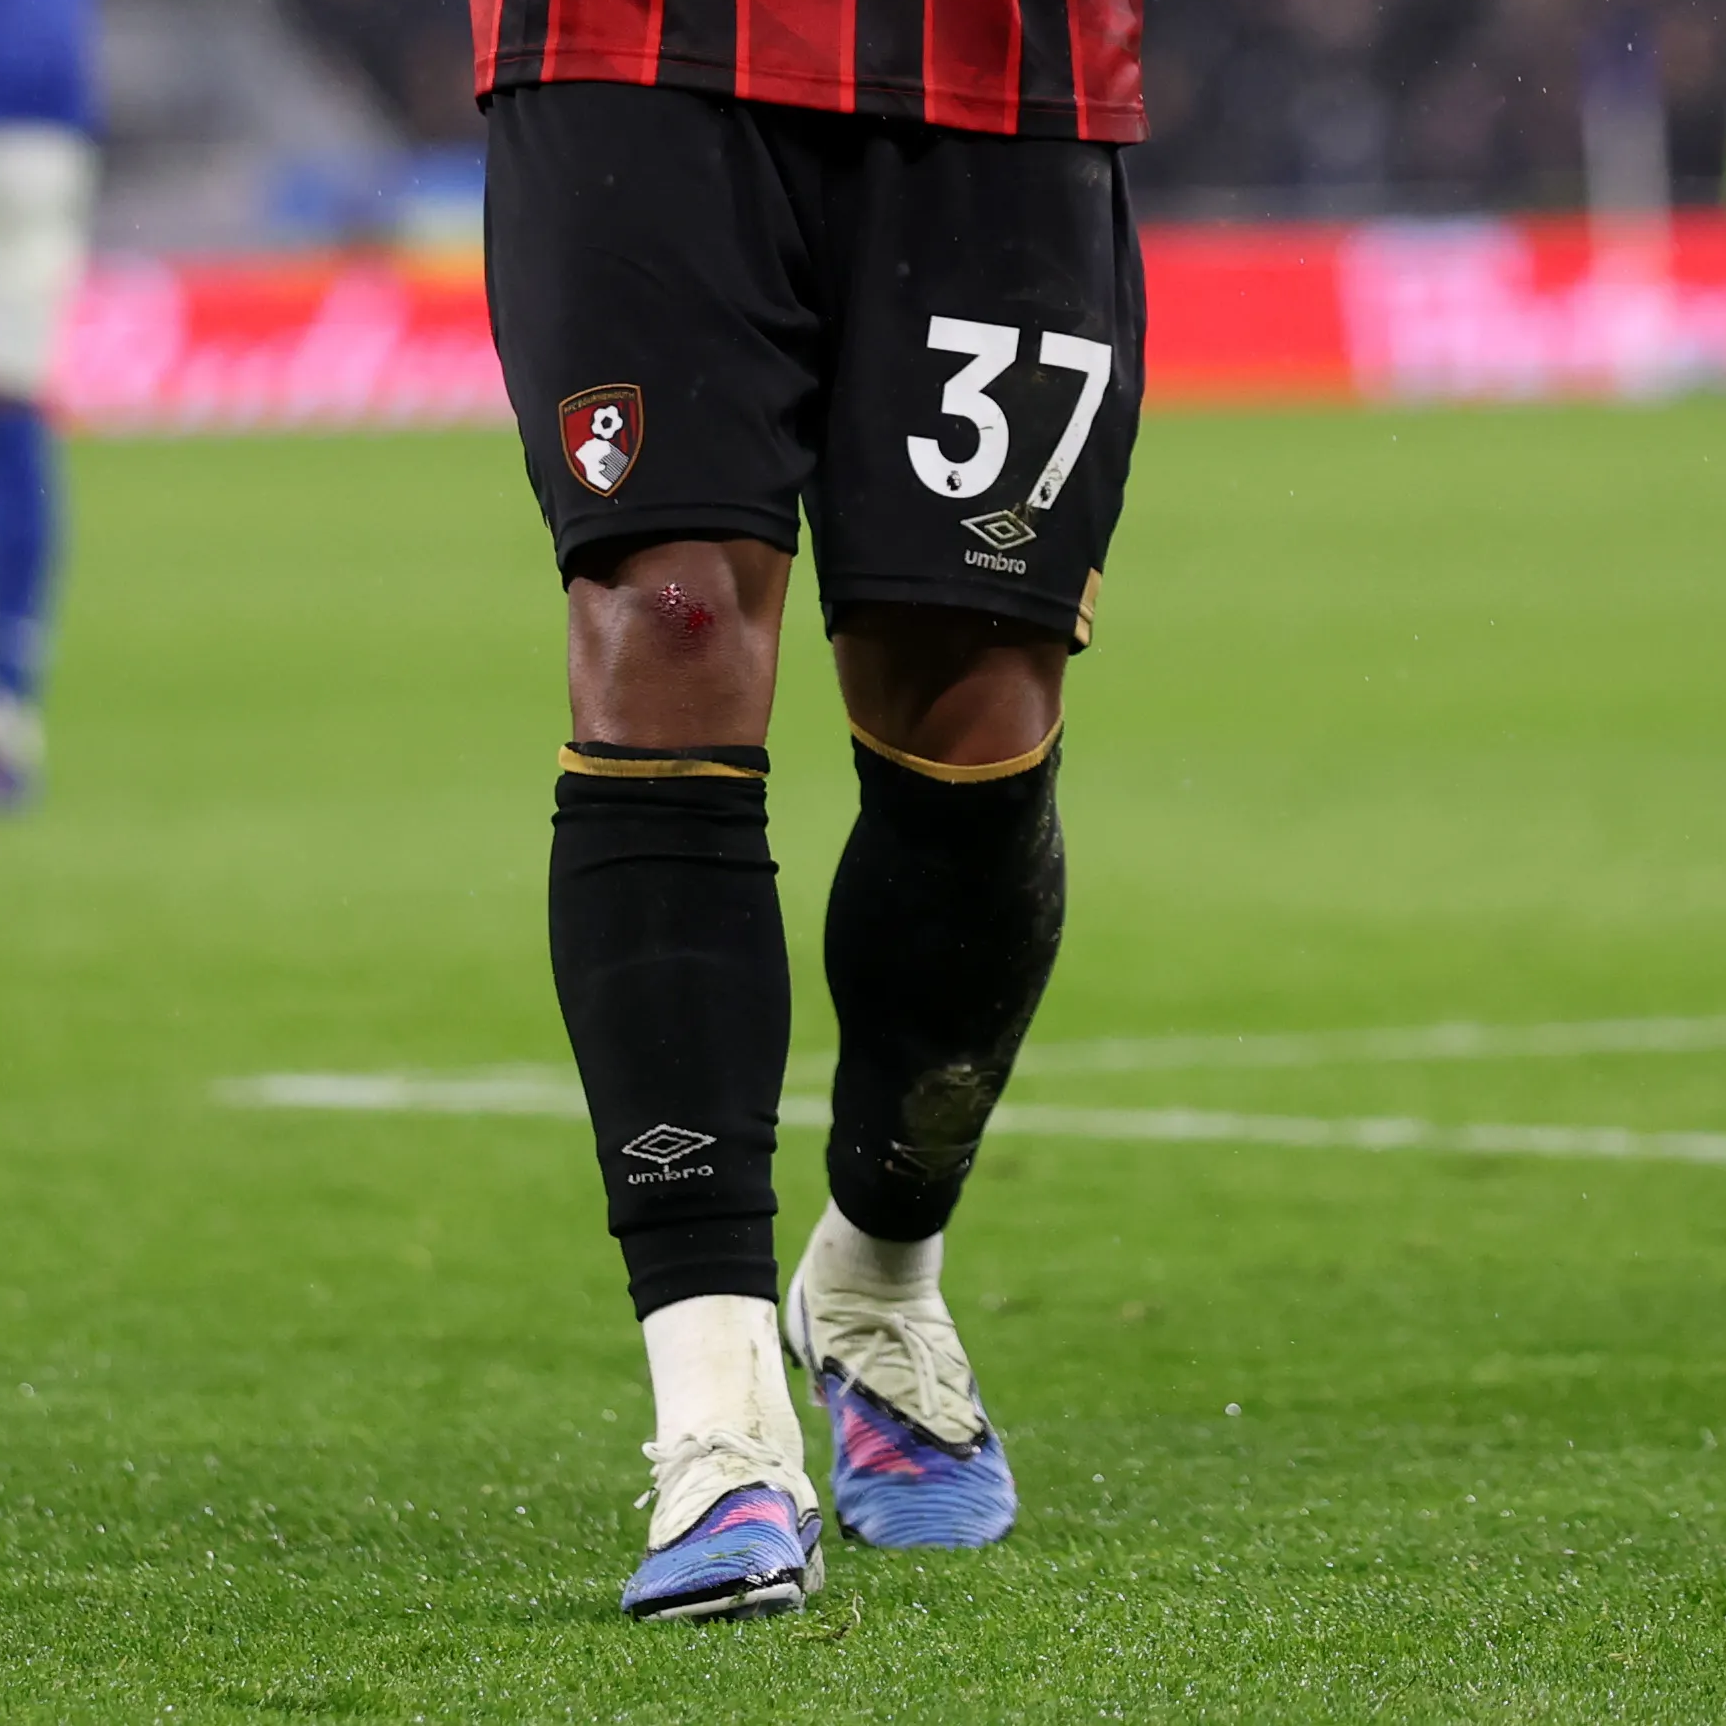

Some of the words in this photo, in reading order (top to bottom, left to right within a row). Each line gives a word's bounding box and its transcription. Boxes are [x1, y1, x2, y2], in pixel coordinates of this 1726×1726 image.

[906, 315, 1112, 510] 37
[964, 548, 1027, 575] umbro
[627, 1164, 714, 1185] umbro
